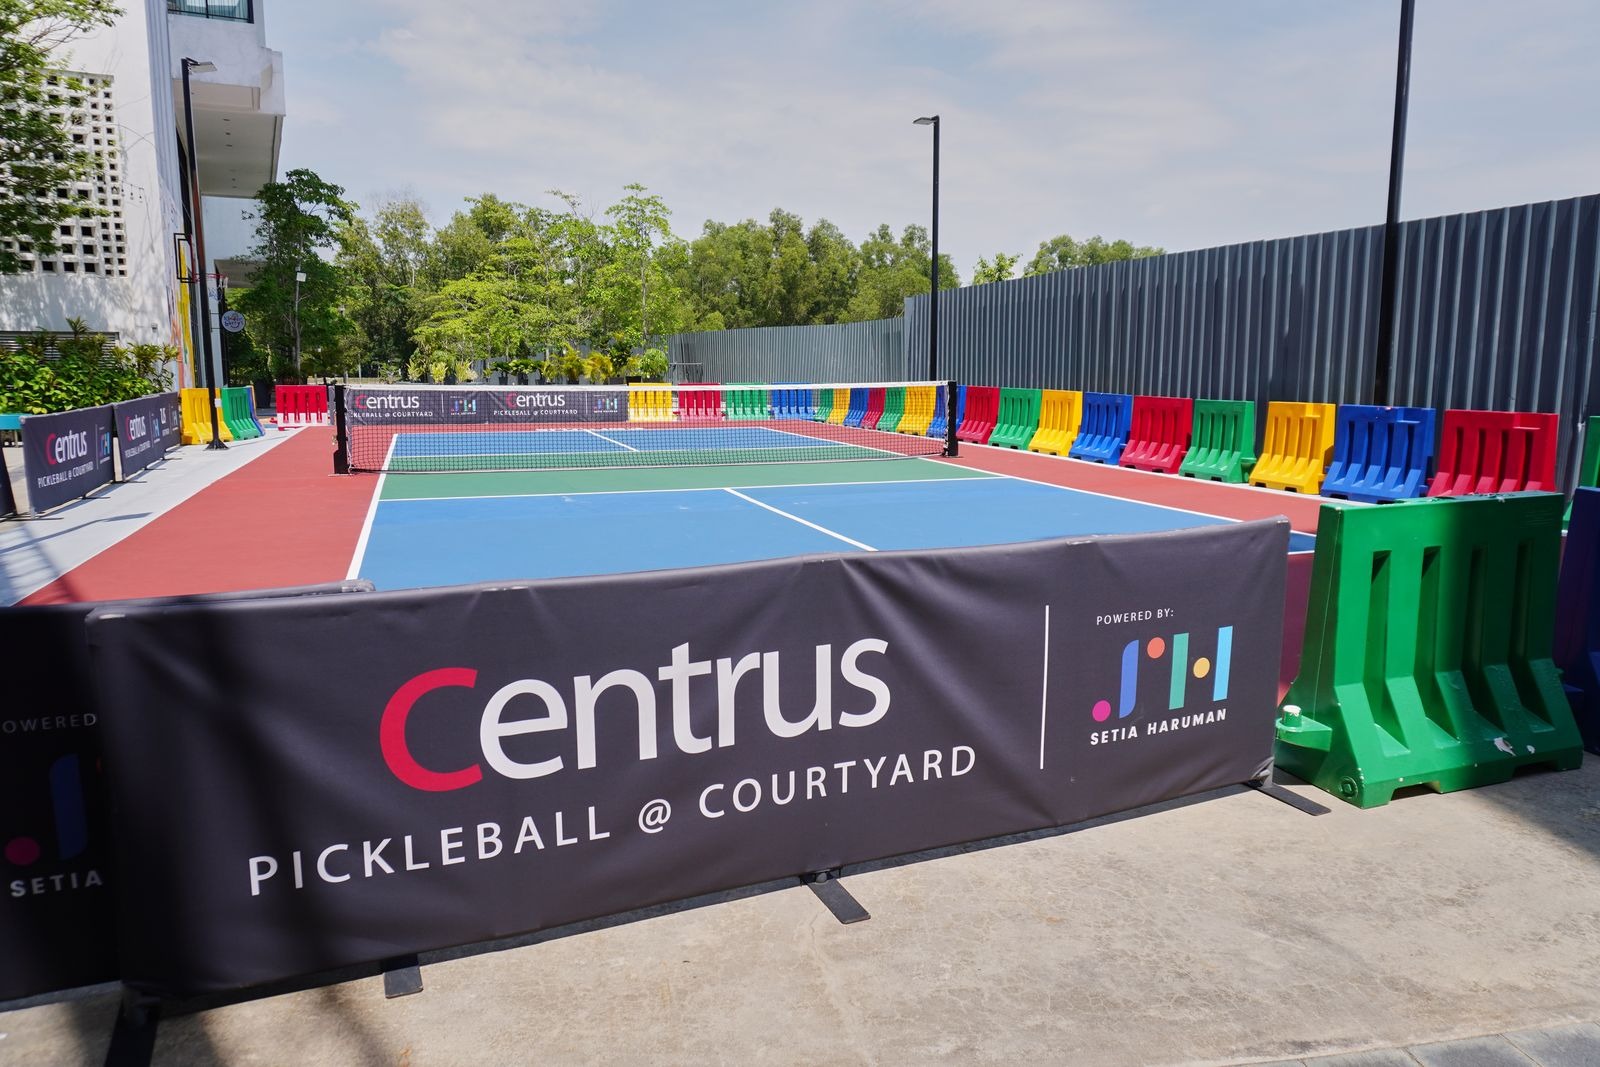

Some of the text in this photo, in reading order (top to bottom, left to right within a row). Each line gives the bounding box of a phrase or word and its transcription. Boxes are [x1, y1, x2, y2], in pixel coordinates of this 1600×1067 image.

[355, 393, 420, 410] Centrus
[506, 391, 565, 408] Centrus
[47, 430, 87, 466] Centrus
[38, 471, 68, 488] PICKLEBALL
[1096, 608, 1175, 626] POWERED BY:
[0, 713, 97, 733] OWERED
[1090, 708, 1227, 746] SETIA HARUMAN
[249, 745, 976, 896] PICKLEBALL @ COURTYARD
[10, 870, 103, 897] SETIA
